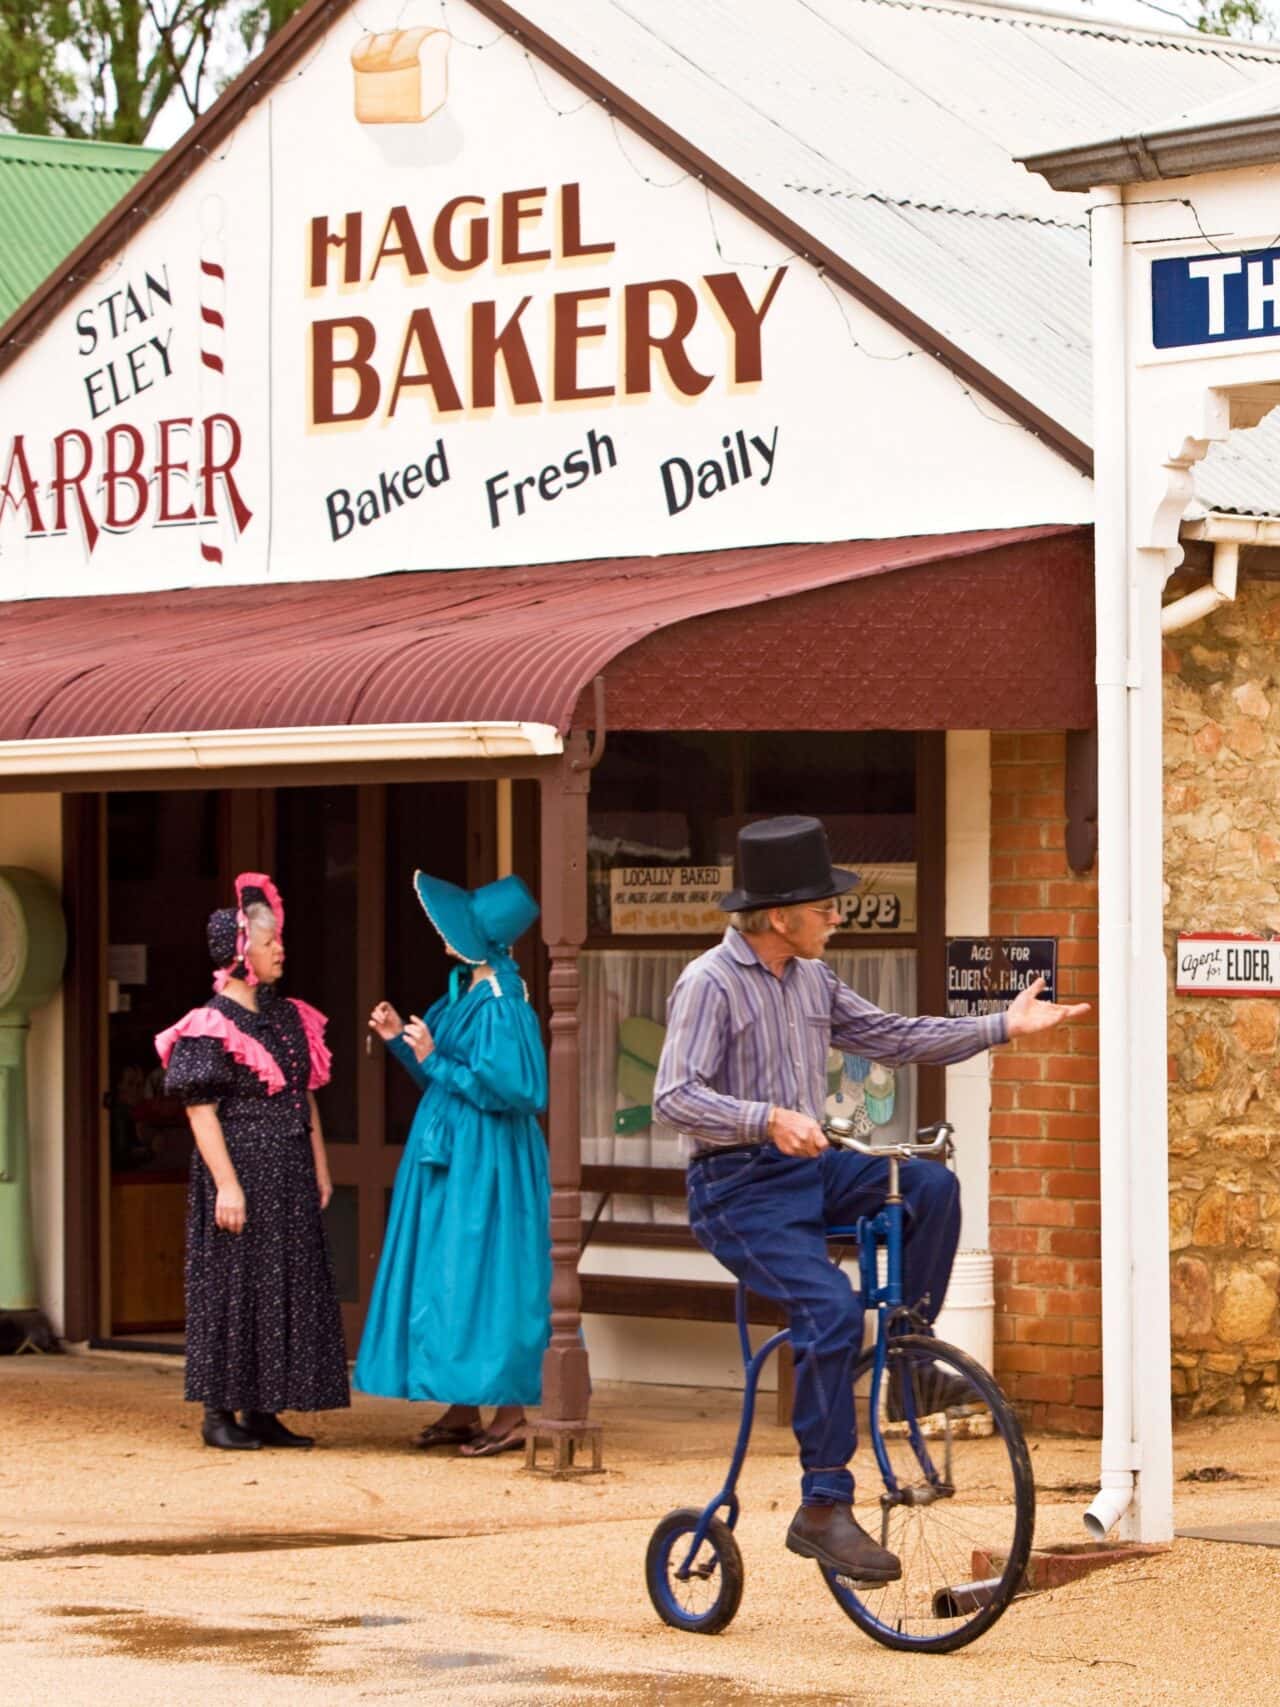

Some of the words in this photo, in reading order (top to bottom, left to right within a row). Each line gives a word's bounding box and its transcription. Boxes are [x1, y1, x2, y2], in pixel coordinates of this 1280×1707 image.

[310, 182, 615, 288] HAGEL
[76, 264, 172, 356] STAN
[312, 266, 788, 425] BAKERY
[84, 328, 173, 419] ELEY
[0, 413, 253, 554] ARBER
[325, 439, 450, 542] Baked
[485, 429, 617, 529] Fresh
[660, 426, 778, 516] Daily
[623, 868, 675, 886] LOCALLY
[681, 868, 720, 885] BAKED
[832, 893, 900, 928] PPE
[948, 966, 980, 991] ELDER
[971, 945, 1008, 960] AGEY
[1011, 947, 1030, 960] FOR
[1226, 949, 1273, 984] ELDER,
